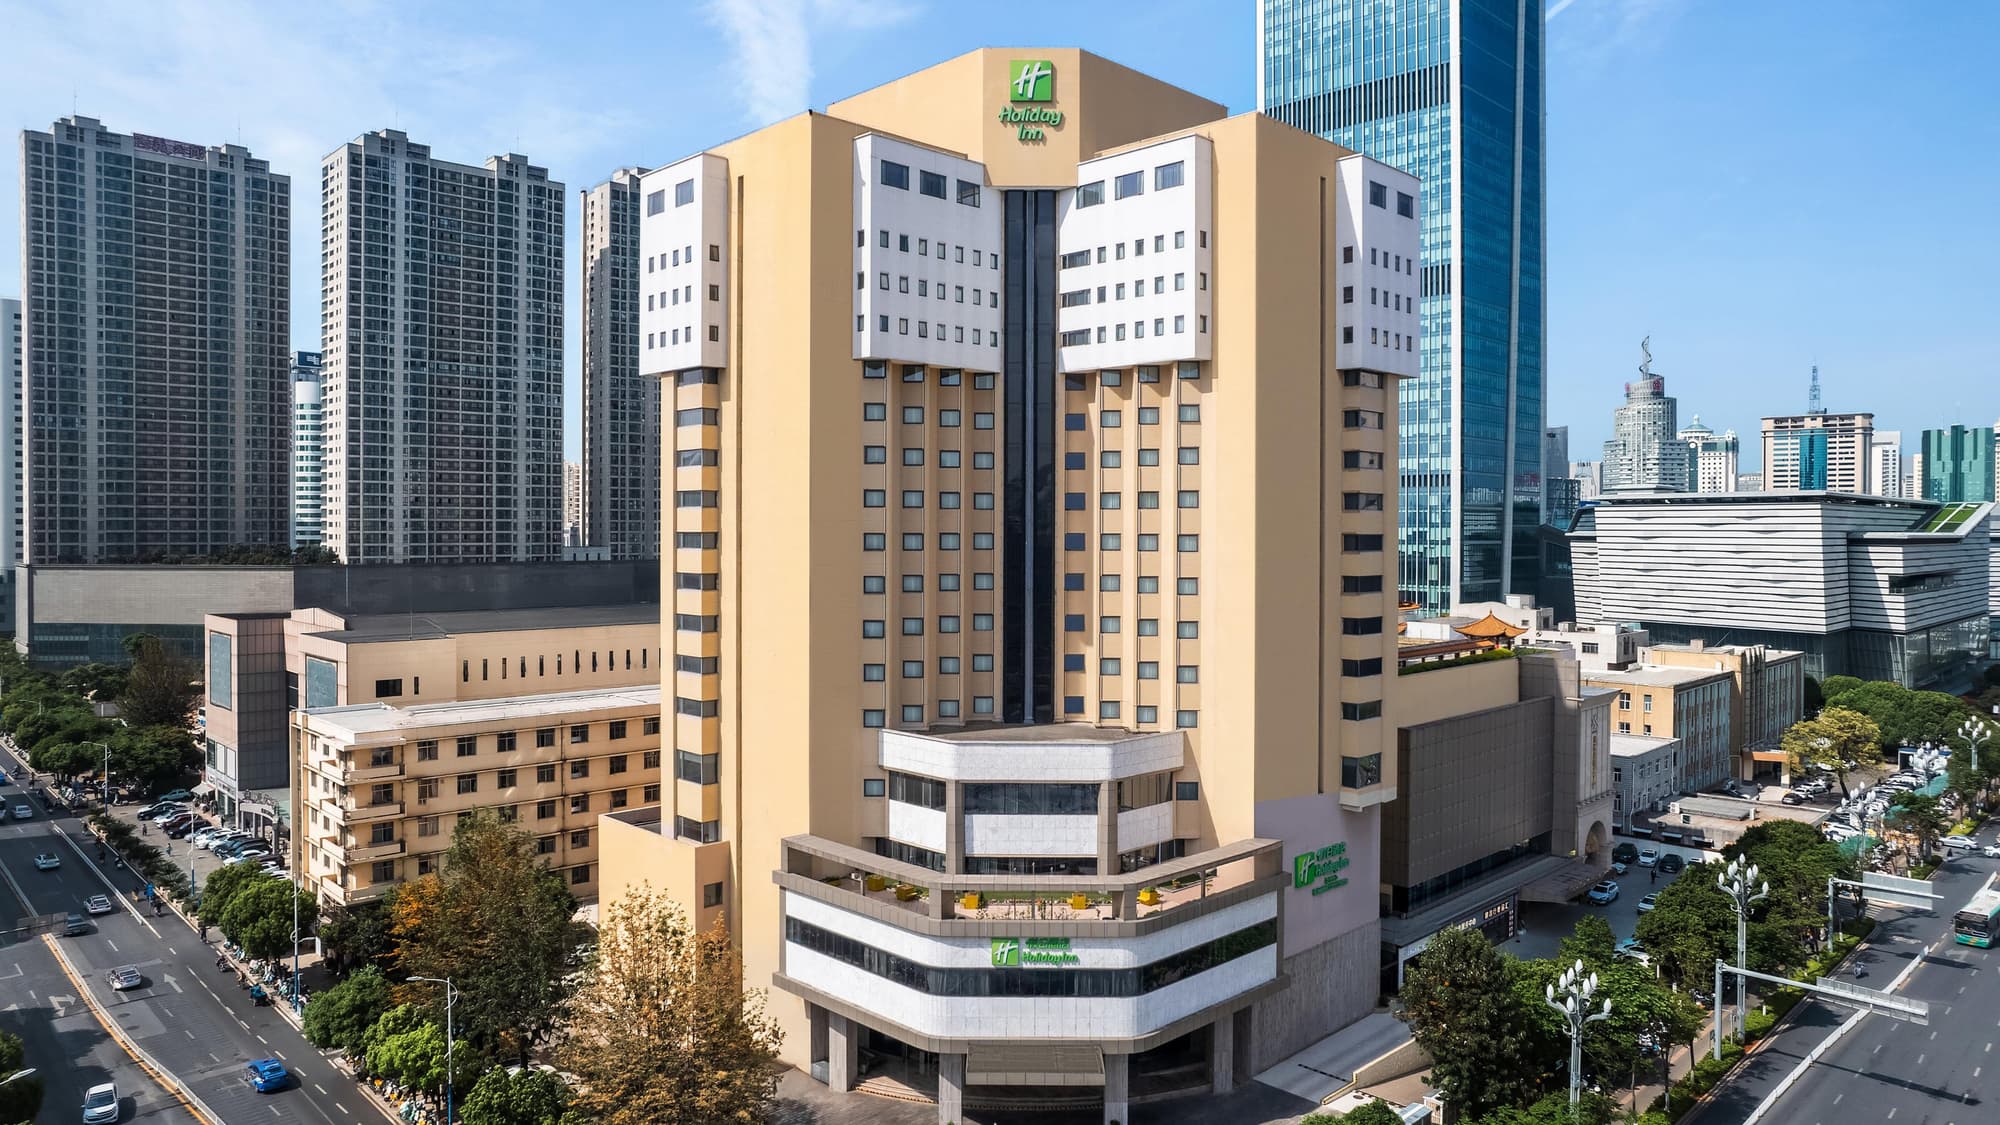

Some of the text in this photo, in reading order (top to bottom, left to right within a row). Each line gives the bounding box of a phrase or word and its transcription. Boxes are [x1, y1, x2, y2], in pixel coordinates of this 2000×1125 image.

[999, 105, 1062, 126] Holiday
[1017, 123, 1044, 140] Inn
[1022, 951, 1080, 965] Holiday Inn
